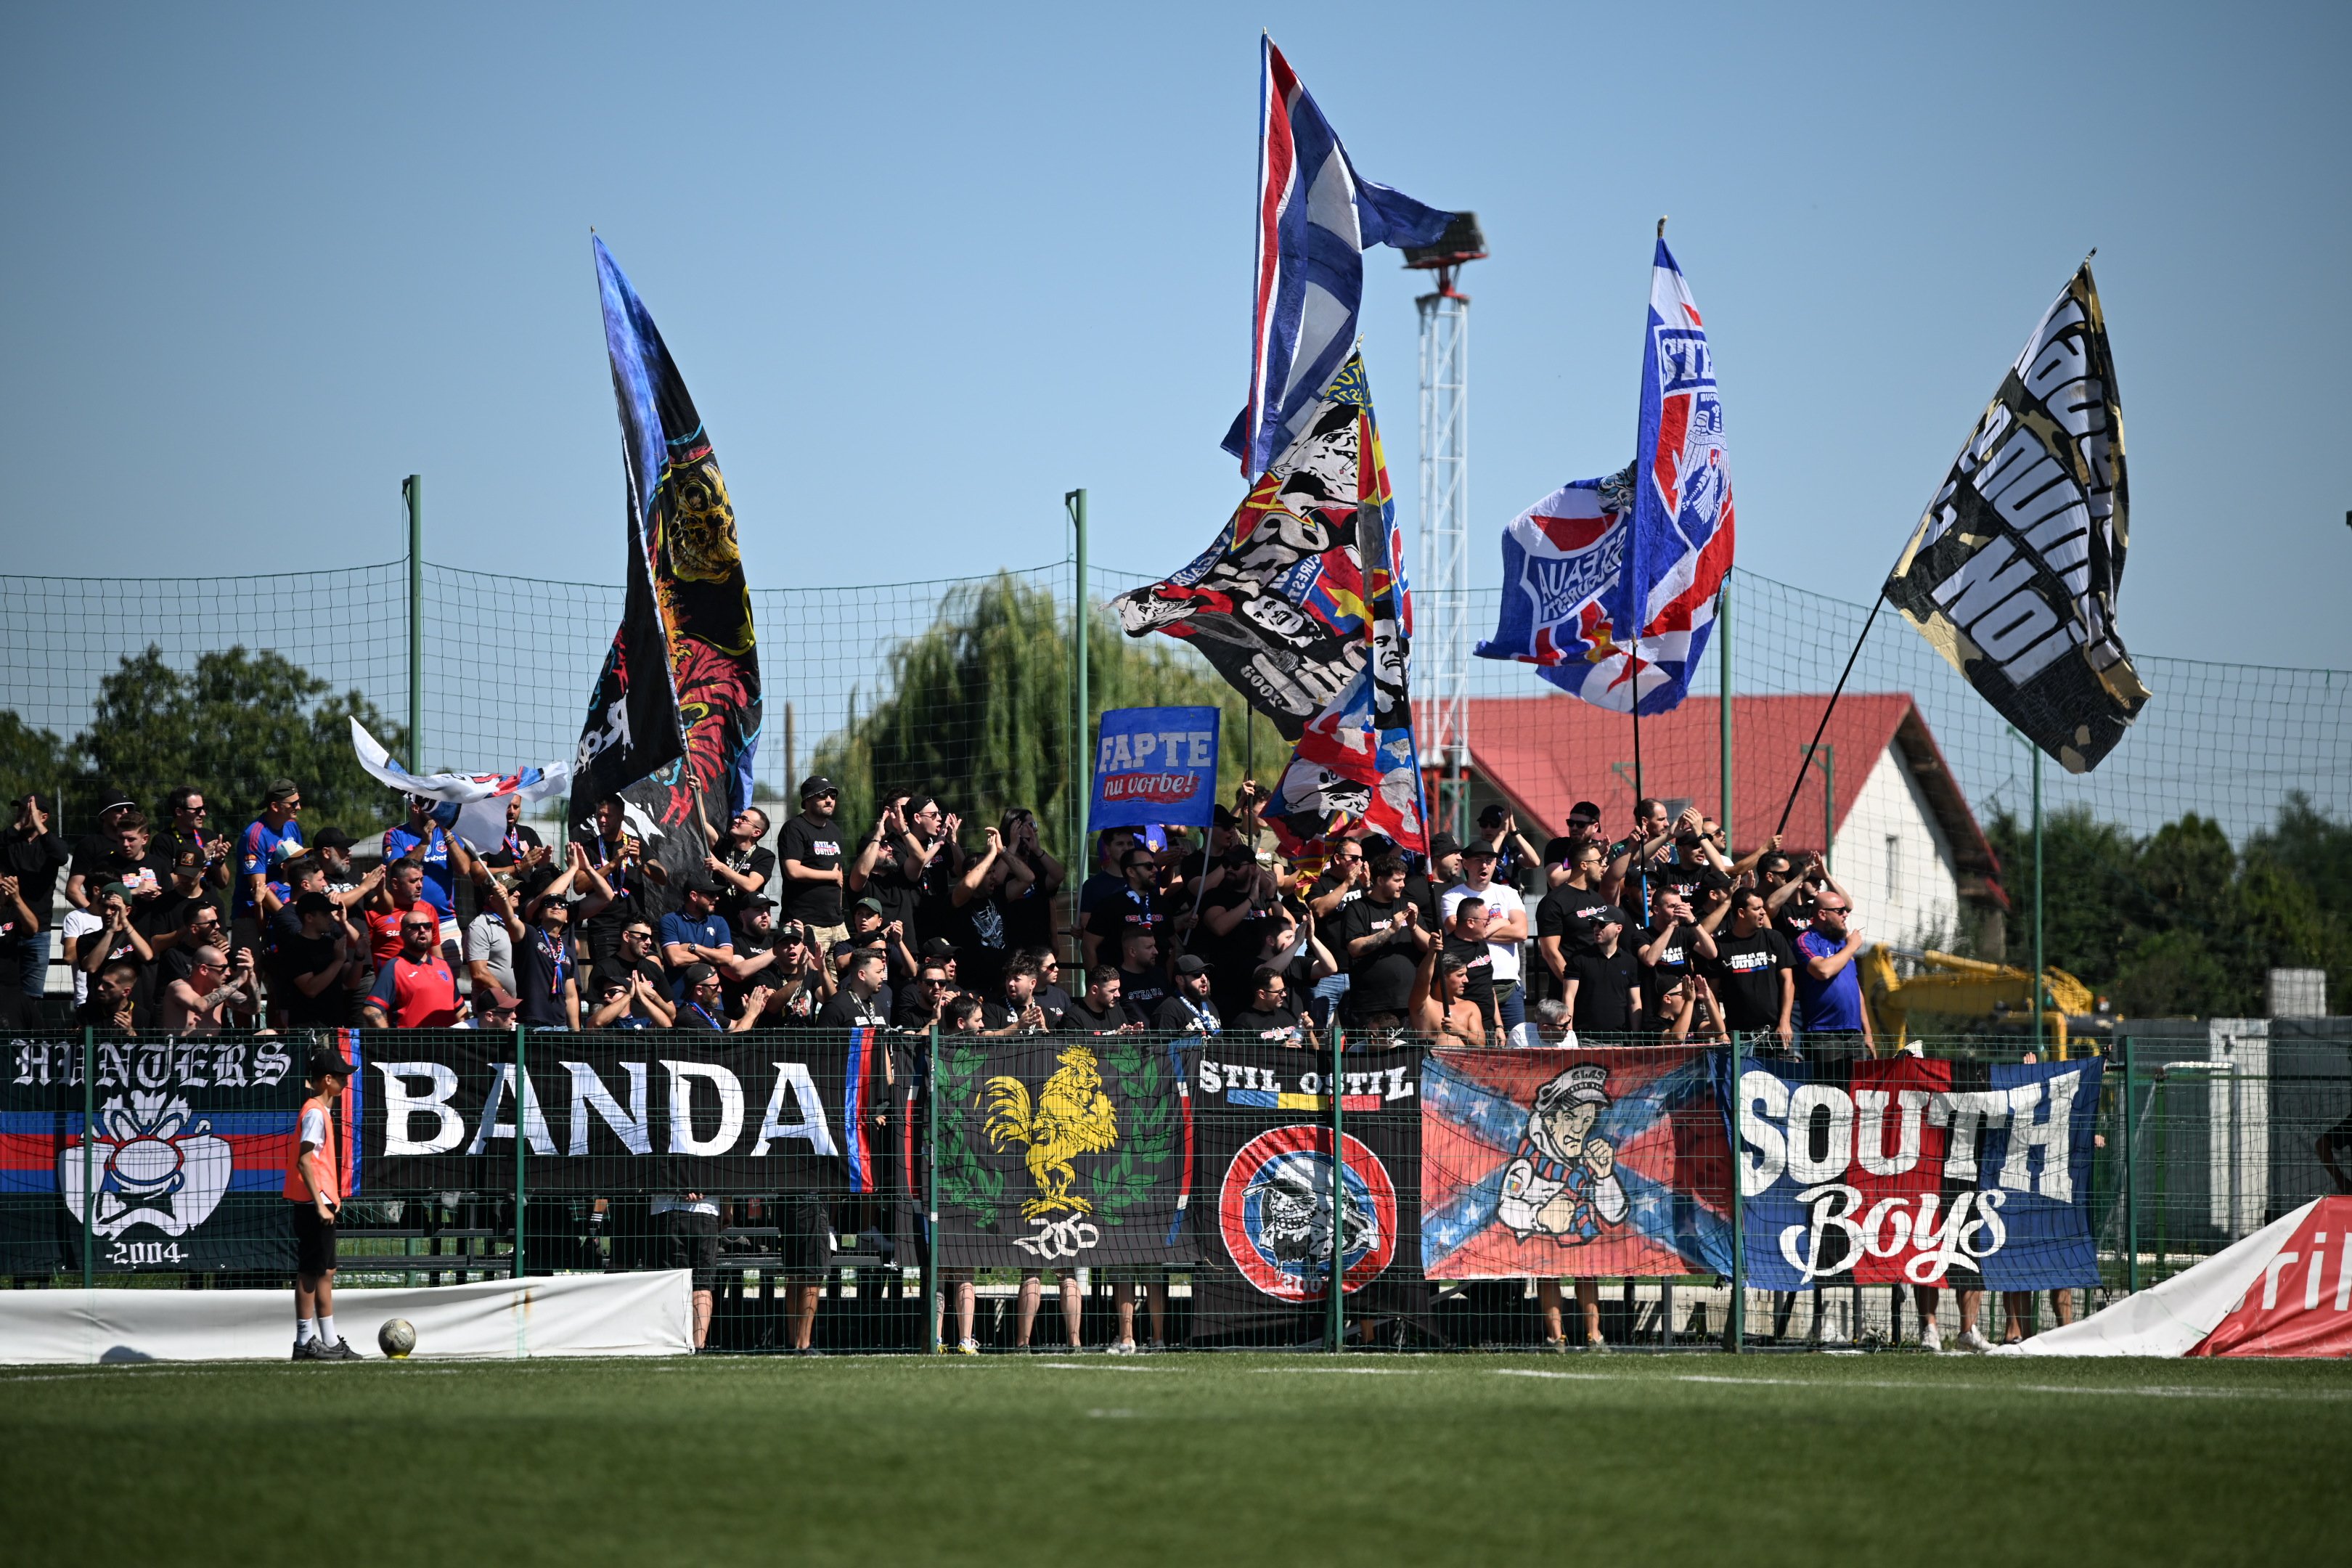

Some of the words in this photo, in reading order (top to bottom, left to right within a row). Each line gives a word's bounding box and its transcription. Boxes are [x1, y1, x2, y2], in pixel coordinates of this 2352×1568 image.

[1098, 731, 1212, 773] FAPTE
[1104, 778, 1123, 798] nu
[1127, 770, 1195, 794] vorbe!
[12, 1034, 291, 1089] HUNTERS
[1199, 1059, 1281, 1093] STIL
[371, 1059, 839, 1156] BANDA
[1739, 1069, 2081, 1204] SOUTH
[1779, 1183, 2008, 1285] Boys
